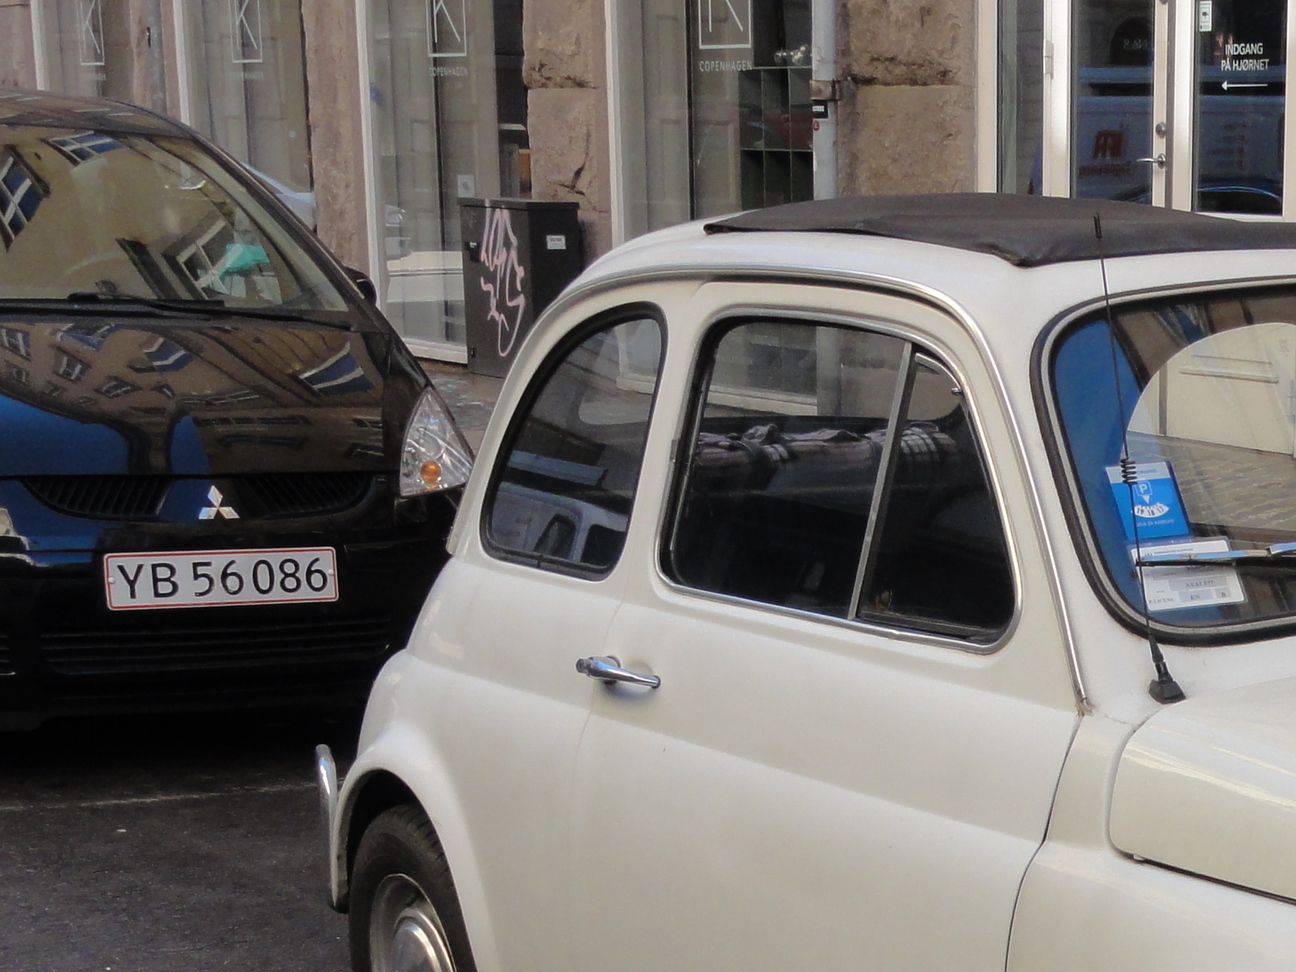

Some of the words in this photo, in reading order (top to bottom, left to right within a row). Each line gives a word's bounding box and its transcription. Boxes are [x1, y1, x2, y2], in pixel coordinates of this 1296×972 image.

[1225, 43, 1264, 55] INDGANG
[699, 60, 753, 72] COPENHAGEN
[1221, 57, 1231, 71] PÅ
[1232, 58, 1270, 71] HJØRNET
[1138, 483, 1148, 494] P
